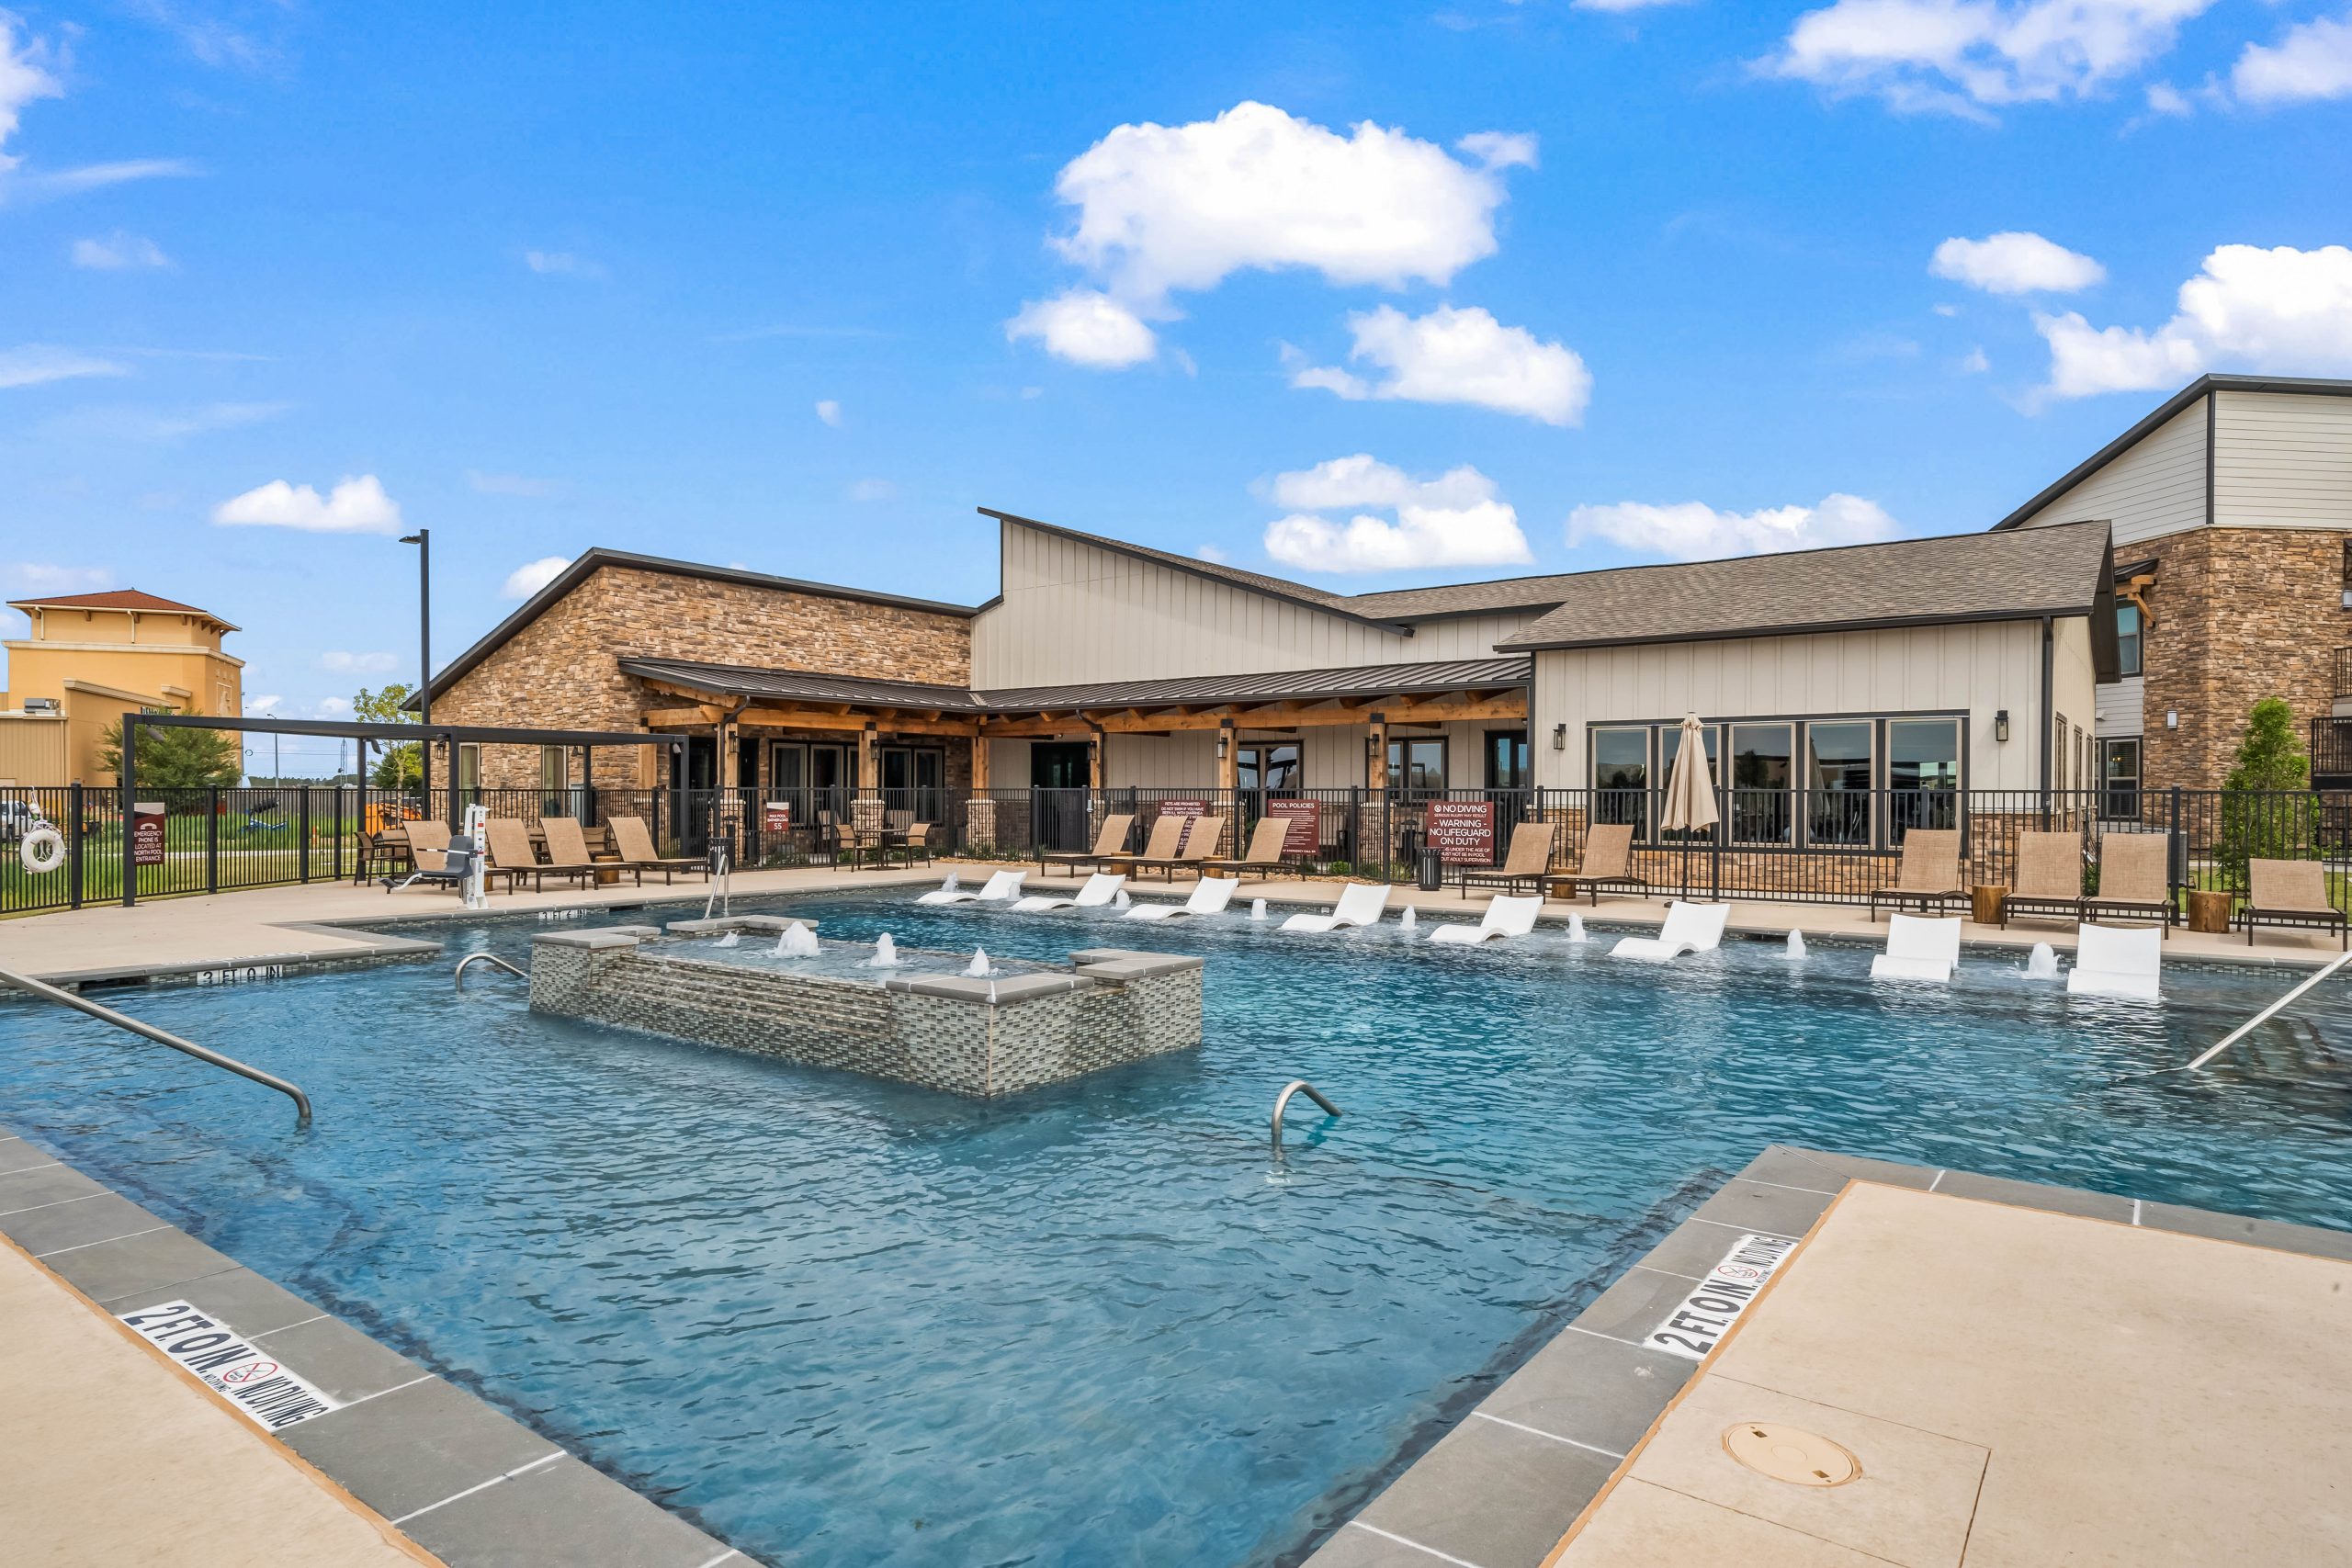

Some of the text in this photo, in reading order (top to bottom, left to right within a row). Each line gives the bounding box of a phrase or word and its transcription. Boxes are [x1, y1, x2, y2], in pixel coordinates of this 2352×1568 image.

[1442, 805, 1487, 814] NO DIVING
[1439, 818, 1482, 828] WARNING
[1430, 828, 1491, 837] NO LIFEGUARD
[1440, 837, 1480, 845] ON DUTY
[1654, 1333, 1713, 1354] 2
[123, 1305, 190, 1326] 2
[244, 1385, 329, 1427] DIVING
